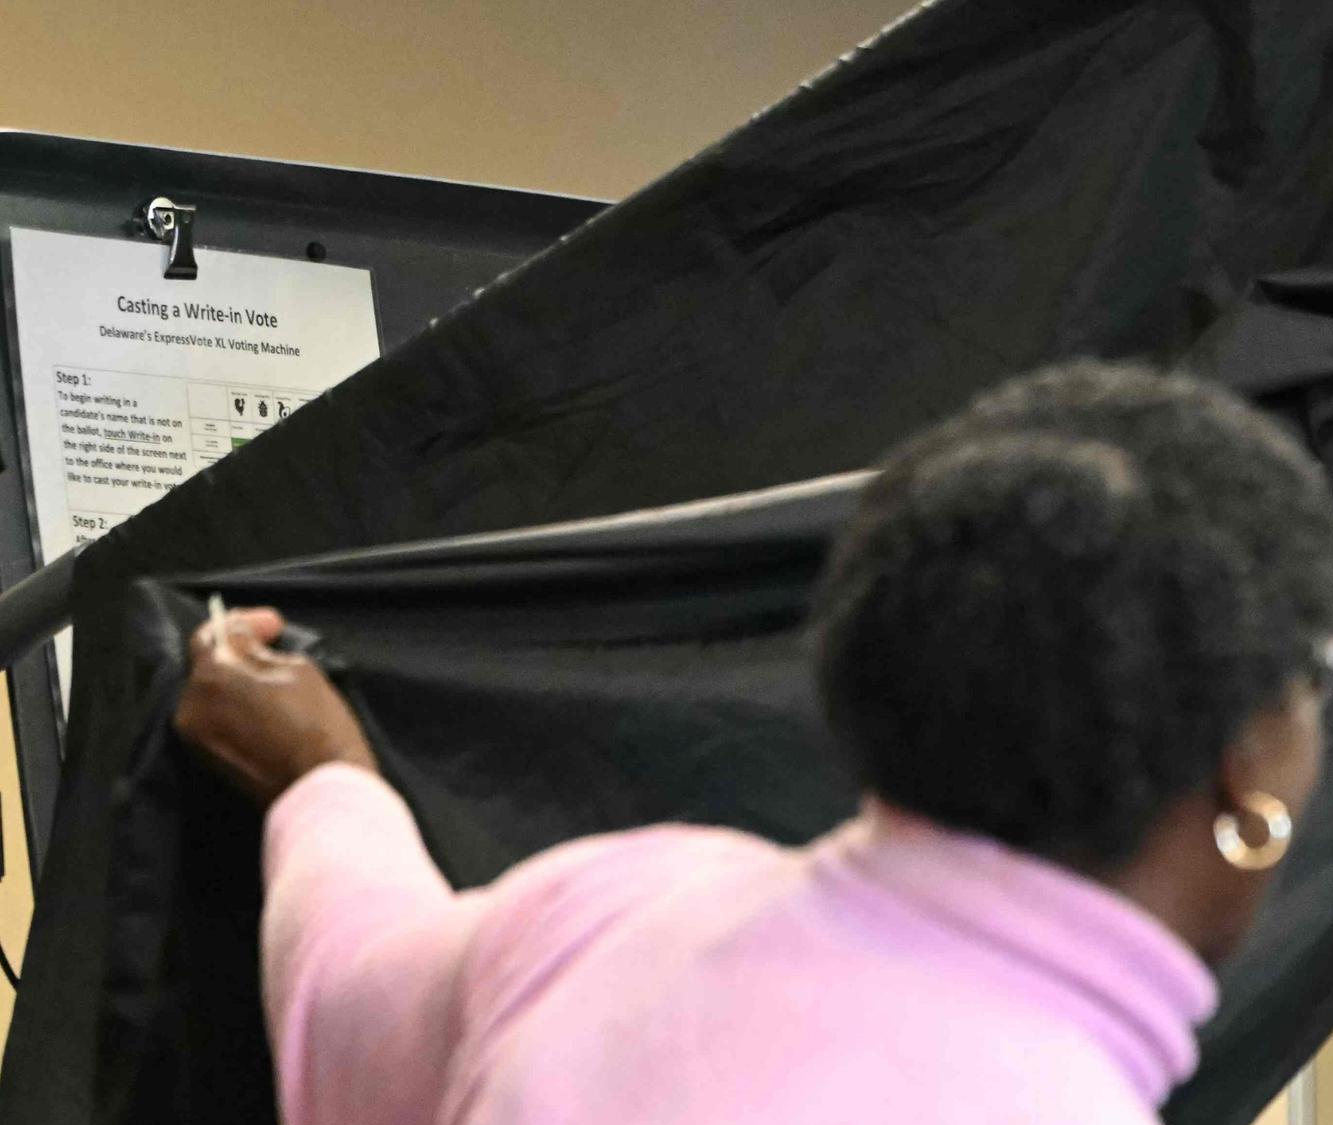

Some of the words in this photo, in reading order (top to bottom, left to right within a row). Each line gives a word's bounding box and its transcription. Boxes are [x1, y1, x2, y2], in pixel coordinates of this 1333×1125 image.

[117, 296, 168, 320] Casting
[173, 305, 181, 318] a
[184, 302, 242, 324] Write-in
[245, 309, 278, 328] Vote
[99, 325, 152, 342] Delaware's
[154, 331, 213, 347] ExpressVote
[215, 337, 226, 349] XL
[229, 338, 258, 355] Voting
[261, 342, 300, 356] Machine
[56, 371, 79, 387] Step
[82, 374, 92, 386] 1:
[58, 390, 68, 400] To
[70, 392, 91, 404] begin
[94, 395, 121, 408] writing
[123, 397, 130, 406] in
[133, 400, 138, 408] a
[106, 413, 129, 423] name
[130, 414, 147, 424] that
[149, 416, 155, 426] is
[157, 418, 170, 427] not
[173, 420, 183, 428] on
[61, 424, 75, 433] the
[104, 428, 126, 439] touch
[128, 430, 160, 443] Write-in
[162, 435, 173, 443] on
[64, 440, 77, 450] the
[79, 441, 97, 453] right
[99, 444, 115, 454] side
[117, 445, 125, 454] of
[127, 446, 140, 456] the
[142, 449, 168, 459] screen
[169, 451, 187, 460] next
[65, 457, 74, 466] to
[76, 458, 89, 467] the
[91, 458, 113, 470] office
[115, 462, 140, 472] where
[142, 465, 156, 475] you
[159, 465, 183, 476] would
[68, 472, 82, 483] like
[83, 474, 92, 483] to
[94, 476, 110, 485] cast
[111, 478, 129, 488] your
[131, 479, 162, 490] write-in
[72, 515, 96, 530] Step
